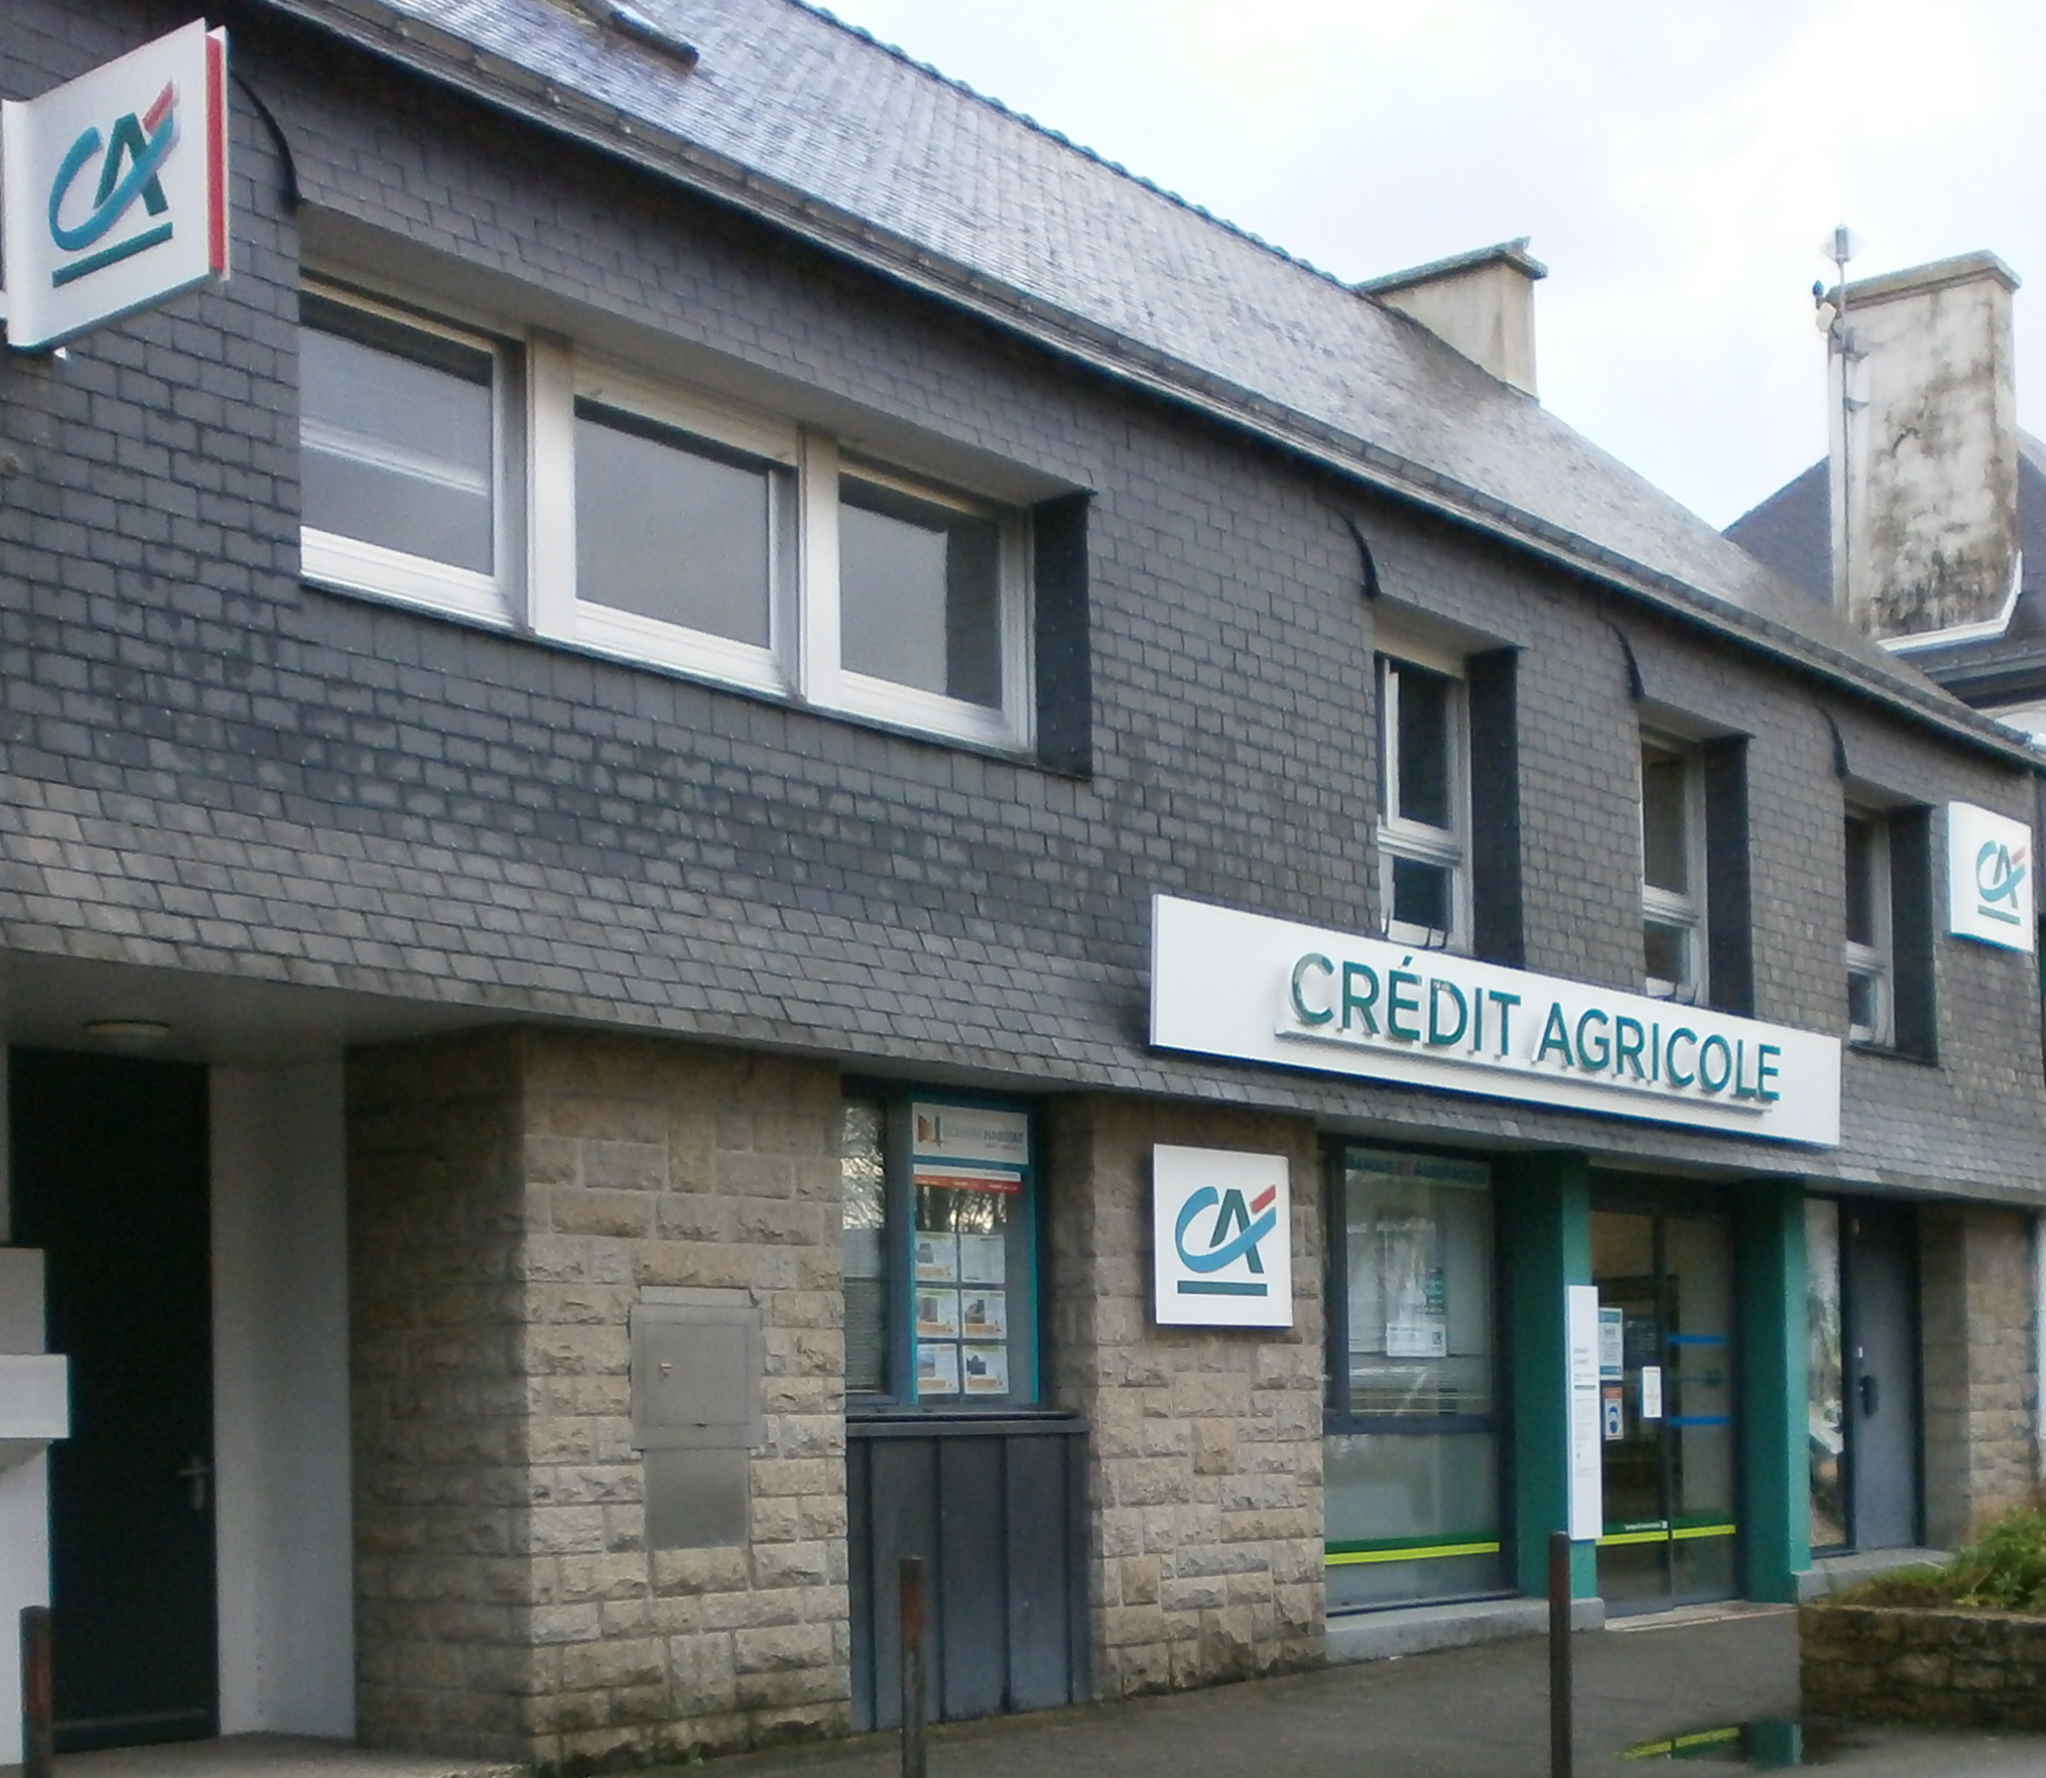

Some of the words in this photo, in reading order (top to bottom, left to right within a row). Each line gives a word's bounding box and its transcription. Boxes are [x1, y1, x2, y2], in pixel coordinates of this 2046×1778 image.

[49, 80, 176, 251] CA
[1291, 952, 1521, 1057] CRÉDIT
[1537, 1001, 1782, 1101] AGRICOLE
[1175, 1185, 1277, 1274] CA
